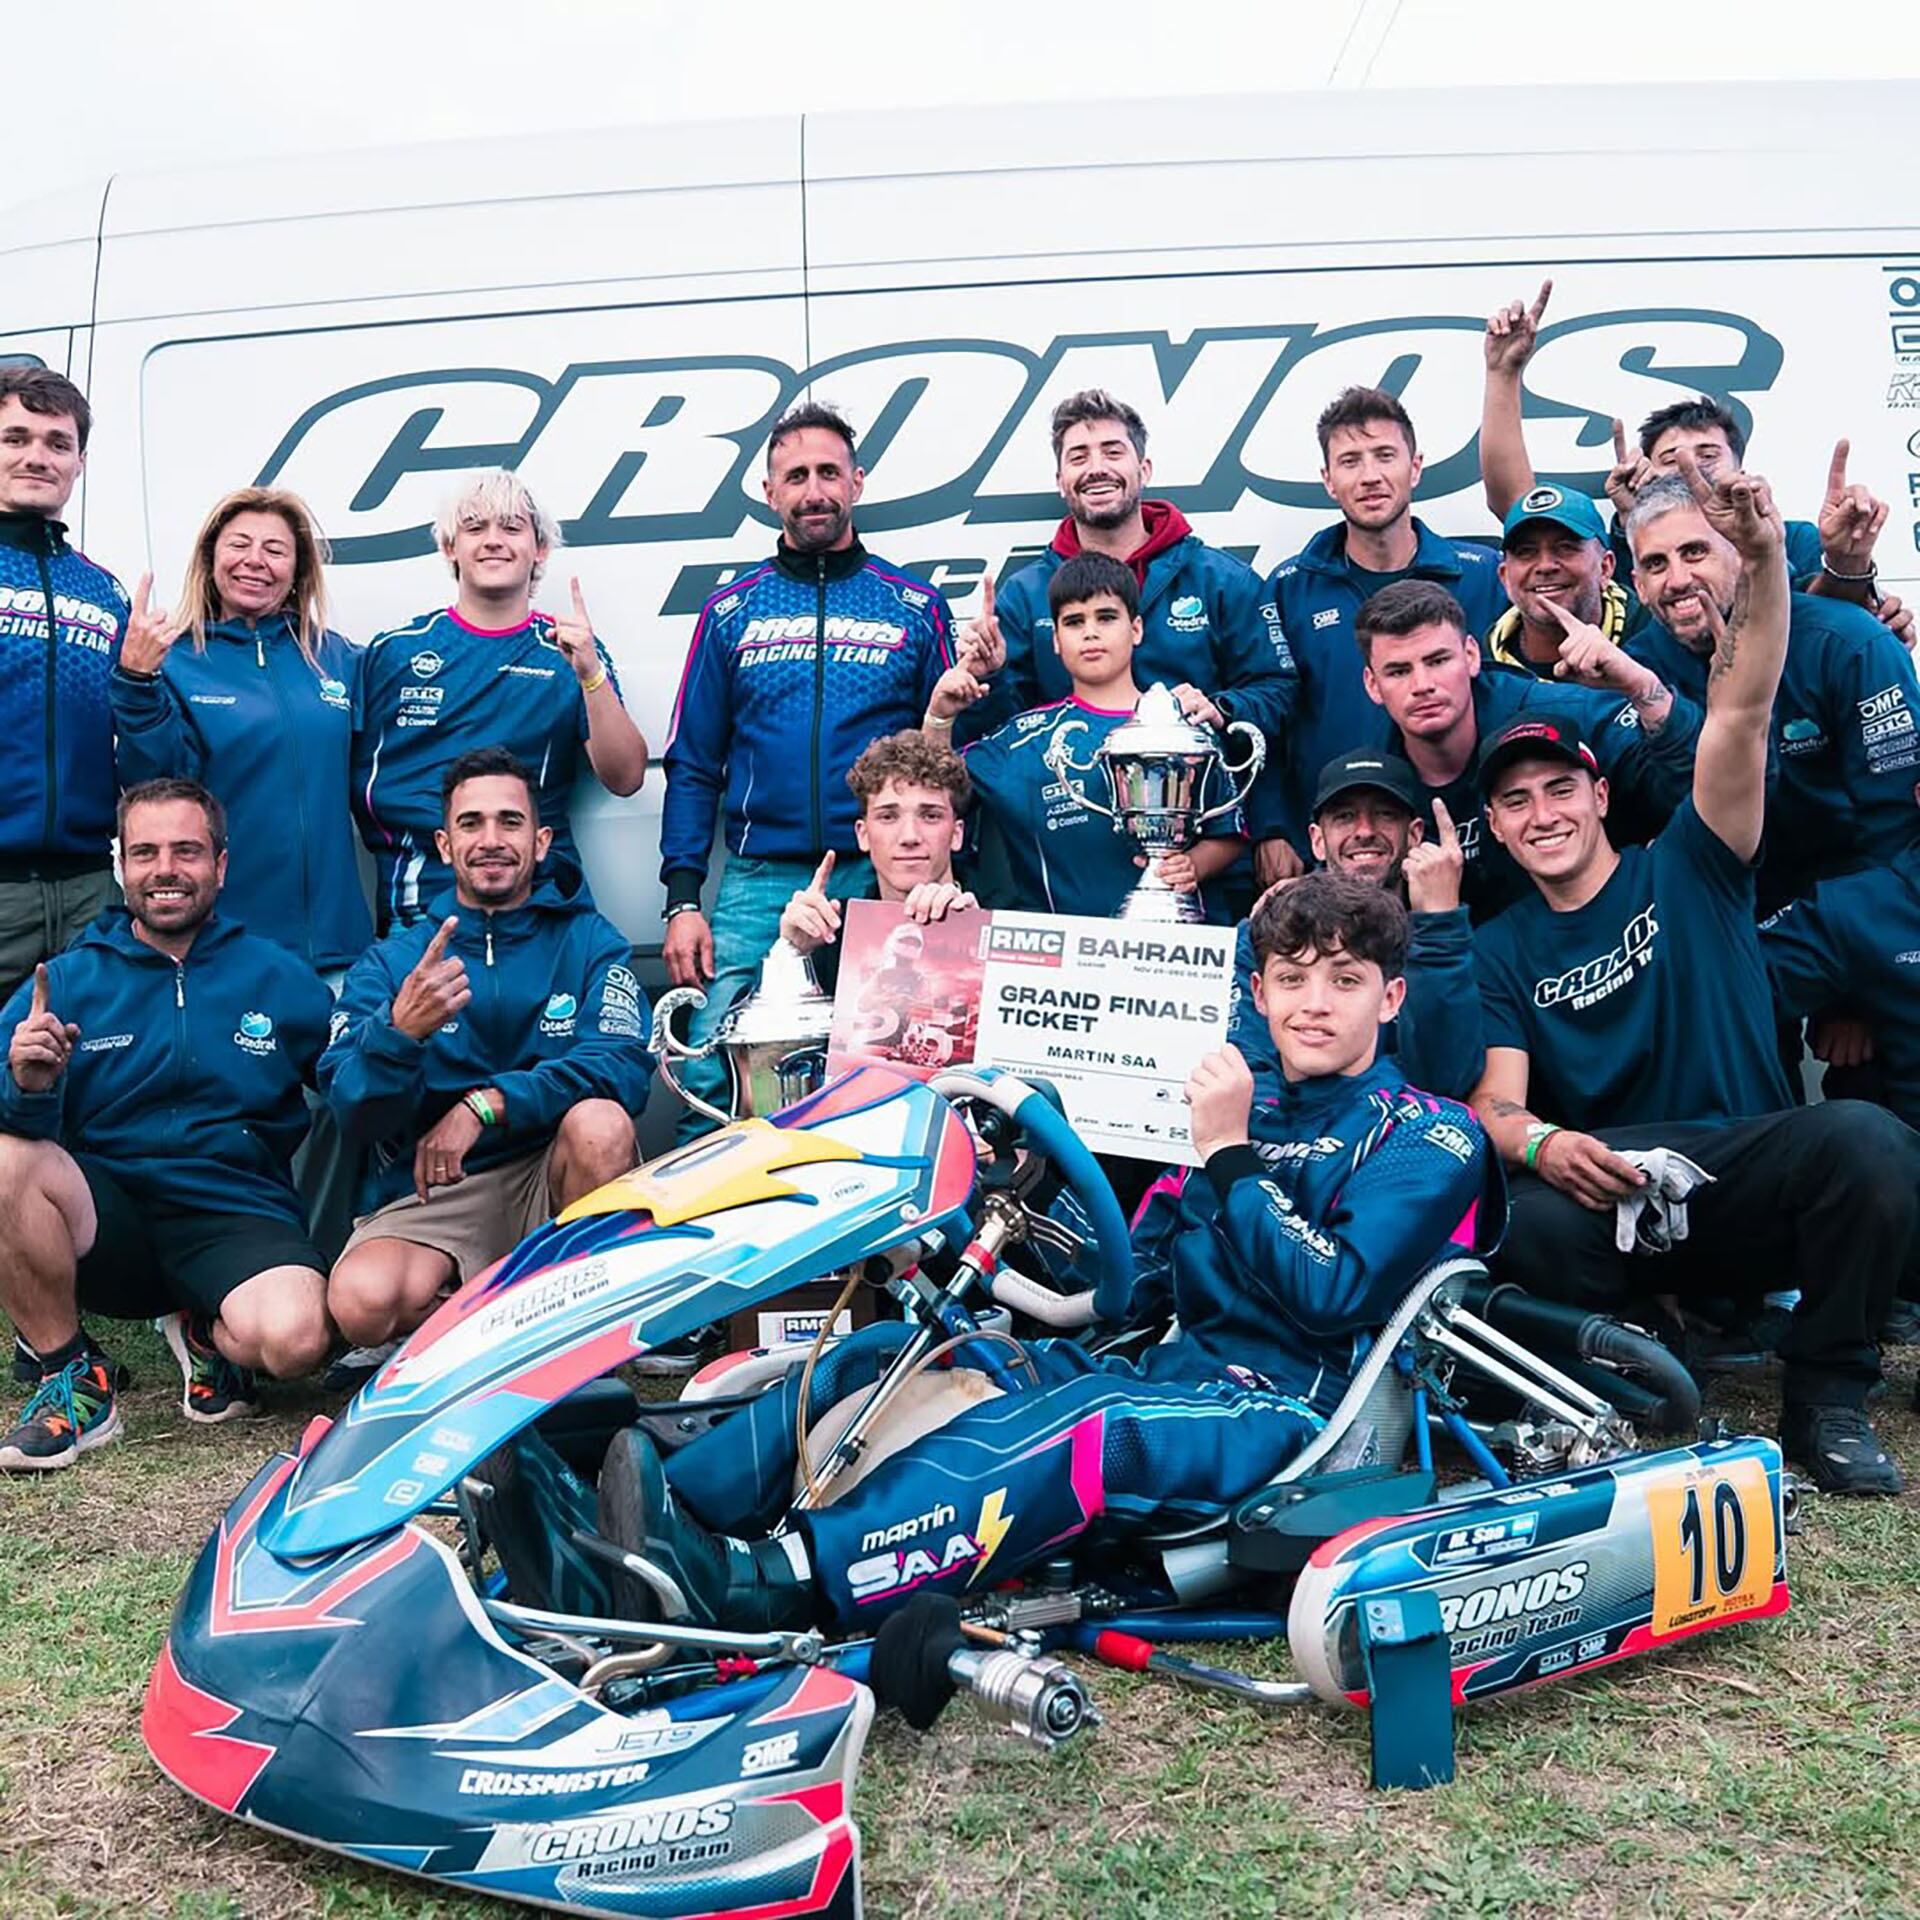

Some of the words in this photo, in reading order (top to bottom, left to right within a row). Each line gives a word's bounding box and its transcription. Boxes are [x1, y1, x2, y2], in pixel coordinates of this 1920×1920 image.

[250, 305, 1785, 566] CRONOS
[65, 625, 111, 655] TEAM
[739, 643, 828, 667] RACING
[832, 645, 890, 665] TEAM
[402, 688, 443, 699] OTK
[1858, 685, 1906, 721] OMP
[990, 929, 1063, 955] RMC
[1077, 936, 1226, 968] BAHRAIN
[1000, 984, 1101, 1011] GRAND
[1109, 996, 1220, 1024] FINALS
[1571, 966, 1635, 1011] Racing
[998, 1006, 1099, 1034] TICKET
[234, 1032, 277, 1051] Catedral
[1046, 1045, 1116, 1064] MARTIN
[1121, 1055, 1157, 1070] SAA
[1679, 1479, 1748, 1608] 10
[847, 1534, 977, 1599] SAA
[1438, 1561, 1590, 1636] RONOS
[1450, 1624, 1520, 1657] acing
[1525, 1605, 1584, 1639] Team
[1577, 1636, 1608, 1662] OMP
[741, 1732, 800, 1777] OMP
[458, 1762, 650, 1797] CROSSMASTER
[530, 1799, 738, 1865] CRONOS
[576, 1852, 657, 1879] Racing
[667, 1840, 732, 1865] Team
